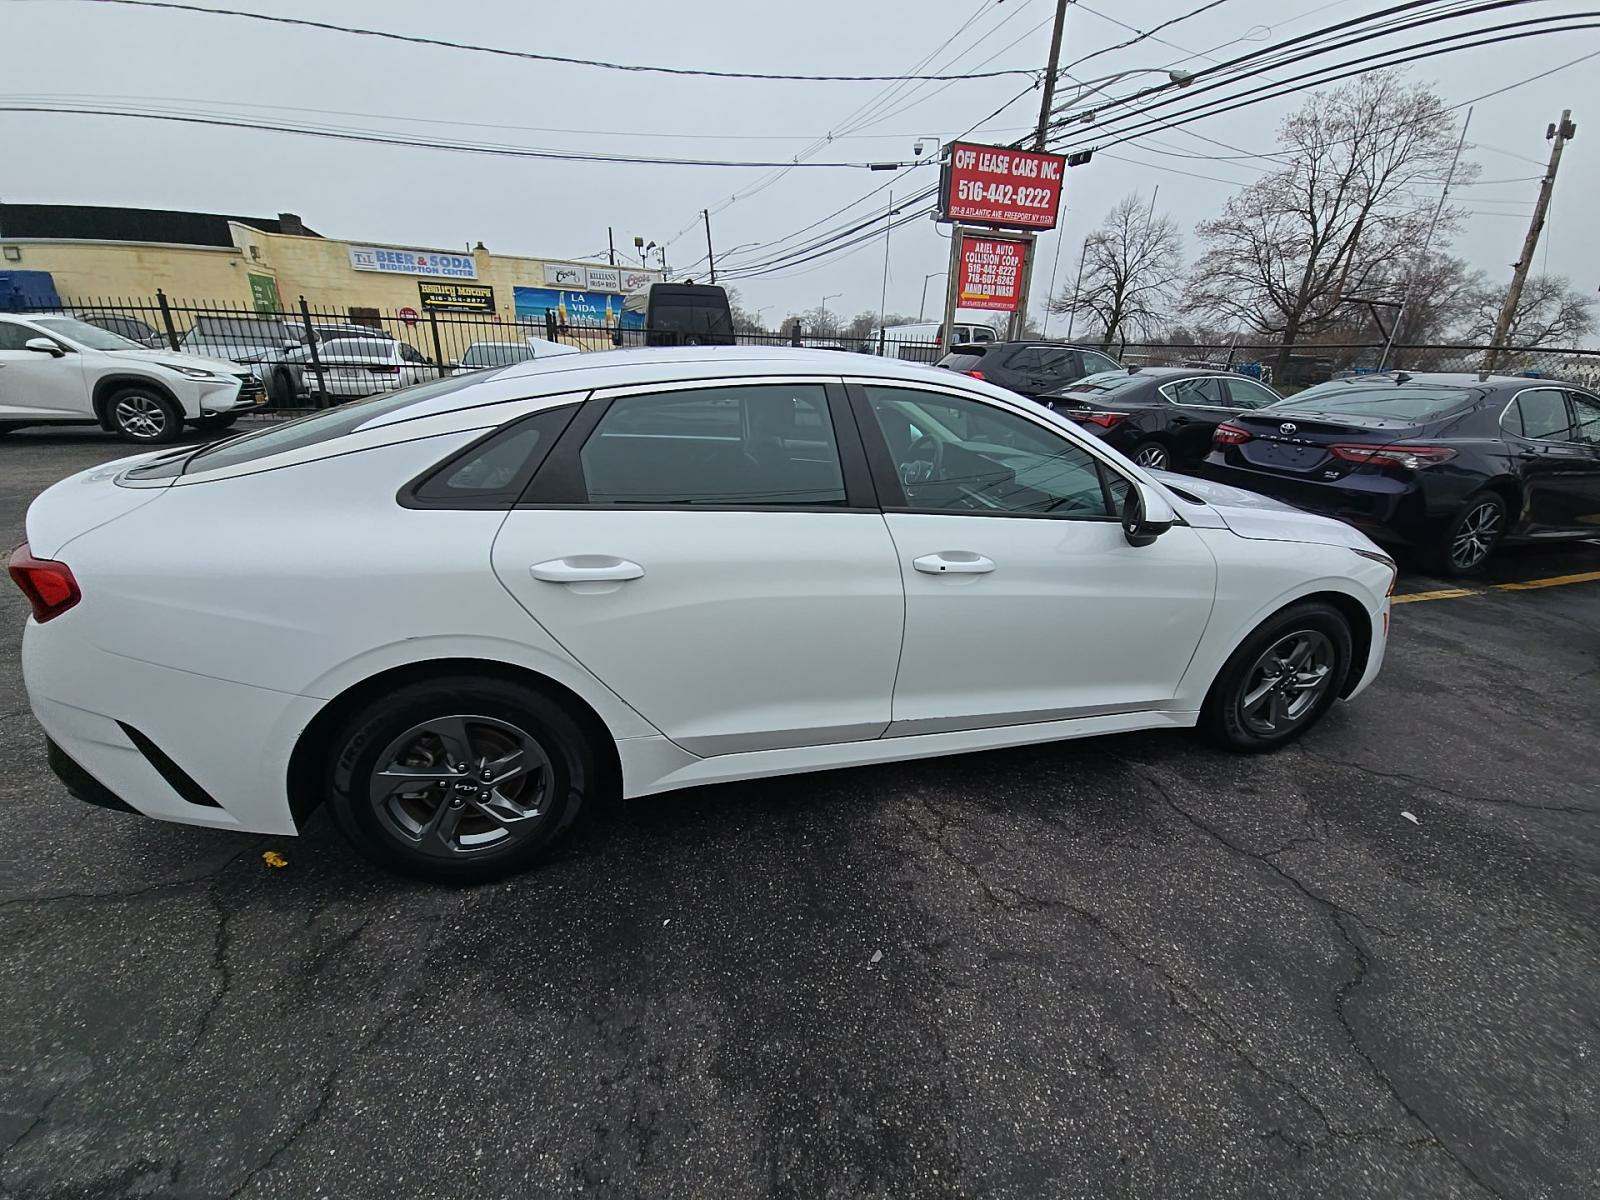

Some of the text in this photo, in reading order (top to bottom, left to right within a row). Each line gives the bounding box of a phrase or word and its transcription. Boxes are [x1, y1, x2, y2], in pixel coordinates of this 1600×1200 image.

[955, 149, 1060, 180] OFF LEASE CARS INC.
[958, 179, 1051, 208] 516-442-8222
[965, 207, 991, 217] ATLANTIC
[1003, 211, 1032, 221] FREEPORT
[975, 242, 1014, 256] ARIEL AUTO
[375, 250, 415, 265] BEER
[417, 255, 427, 266] &
[429, 255, 473, 270] SODA
[965, 252, 1000, 265] COLLISION
[379, 262, 474, 277] REDEMPTION CENTER
[982, 283, 995, 296] CAR
[571, 294, 585, 303] LA
[571, 303, 597, 313] VIDA
